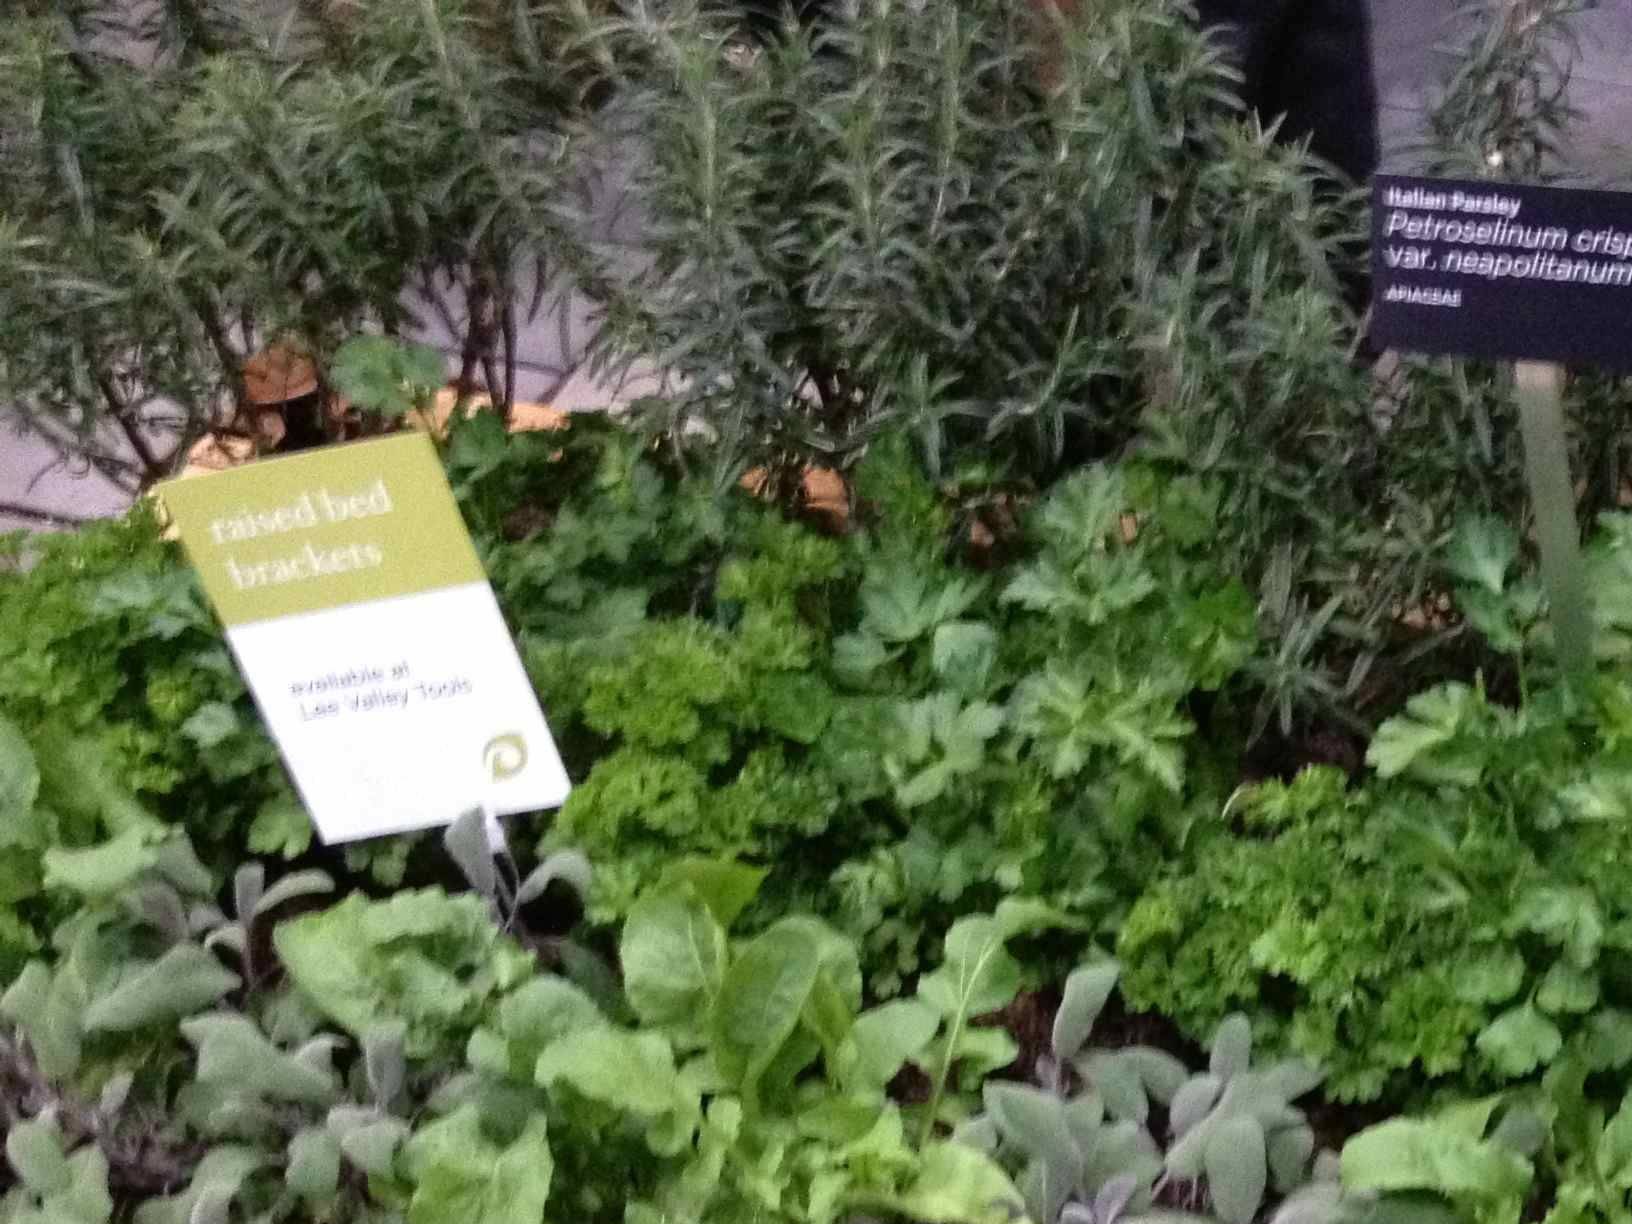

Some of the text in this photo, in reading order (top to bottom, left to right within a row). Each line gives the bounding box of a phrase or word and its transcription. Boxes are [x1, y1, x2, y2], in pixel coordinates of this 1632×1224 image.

[1384, 186, 1521, 218] Italian Parsley
[1384, 209, 1569, 250] Petroselinum
[209, 478, 394, 545] raised bed
[226, 538, 384, 590] brackets
